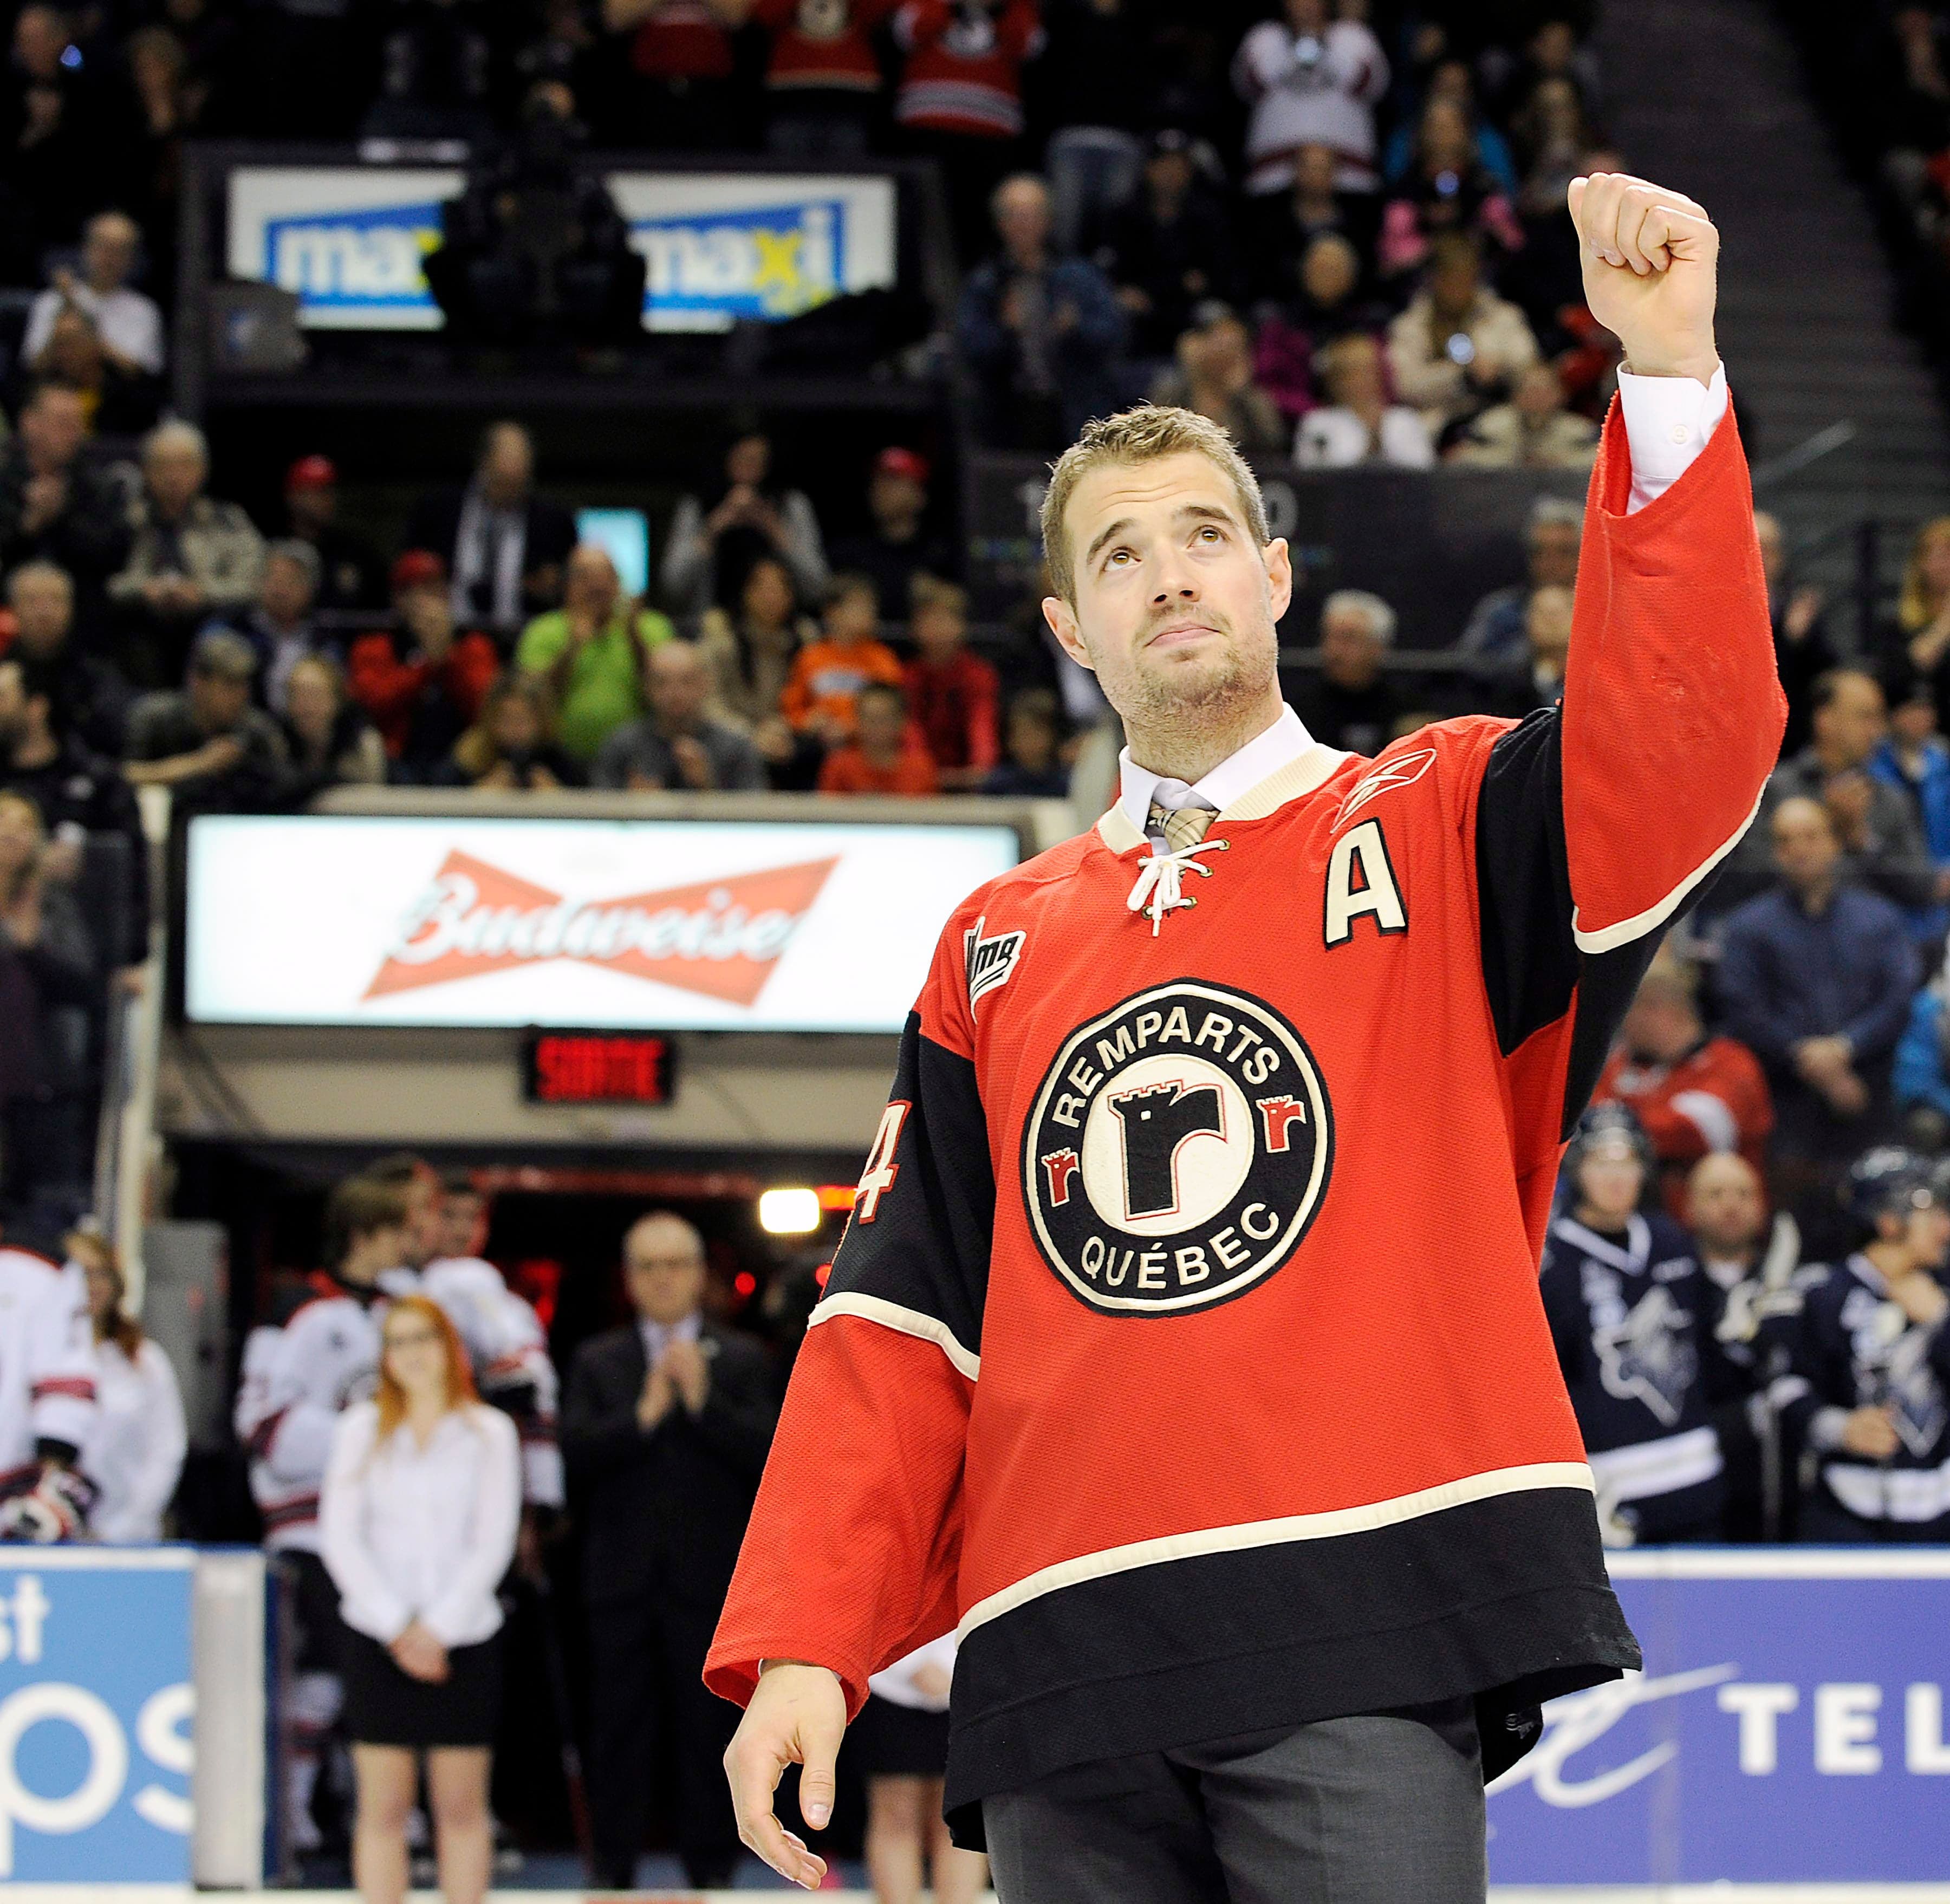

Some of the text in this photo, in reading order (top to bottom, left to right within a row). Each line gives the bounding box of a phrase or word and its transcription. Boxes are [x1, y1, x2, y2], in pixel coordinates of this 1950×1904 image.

[626, 209, 834, 297] maxi
[1323, 816, 1409, 951] A
[1052, 1006, 1280, 1128] REMPARTS
[1081, 1203, 1280, 1289] QUÉBEC
[1716, 1682, 1950, 1776] TEL
